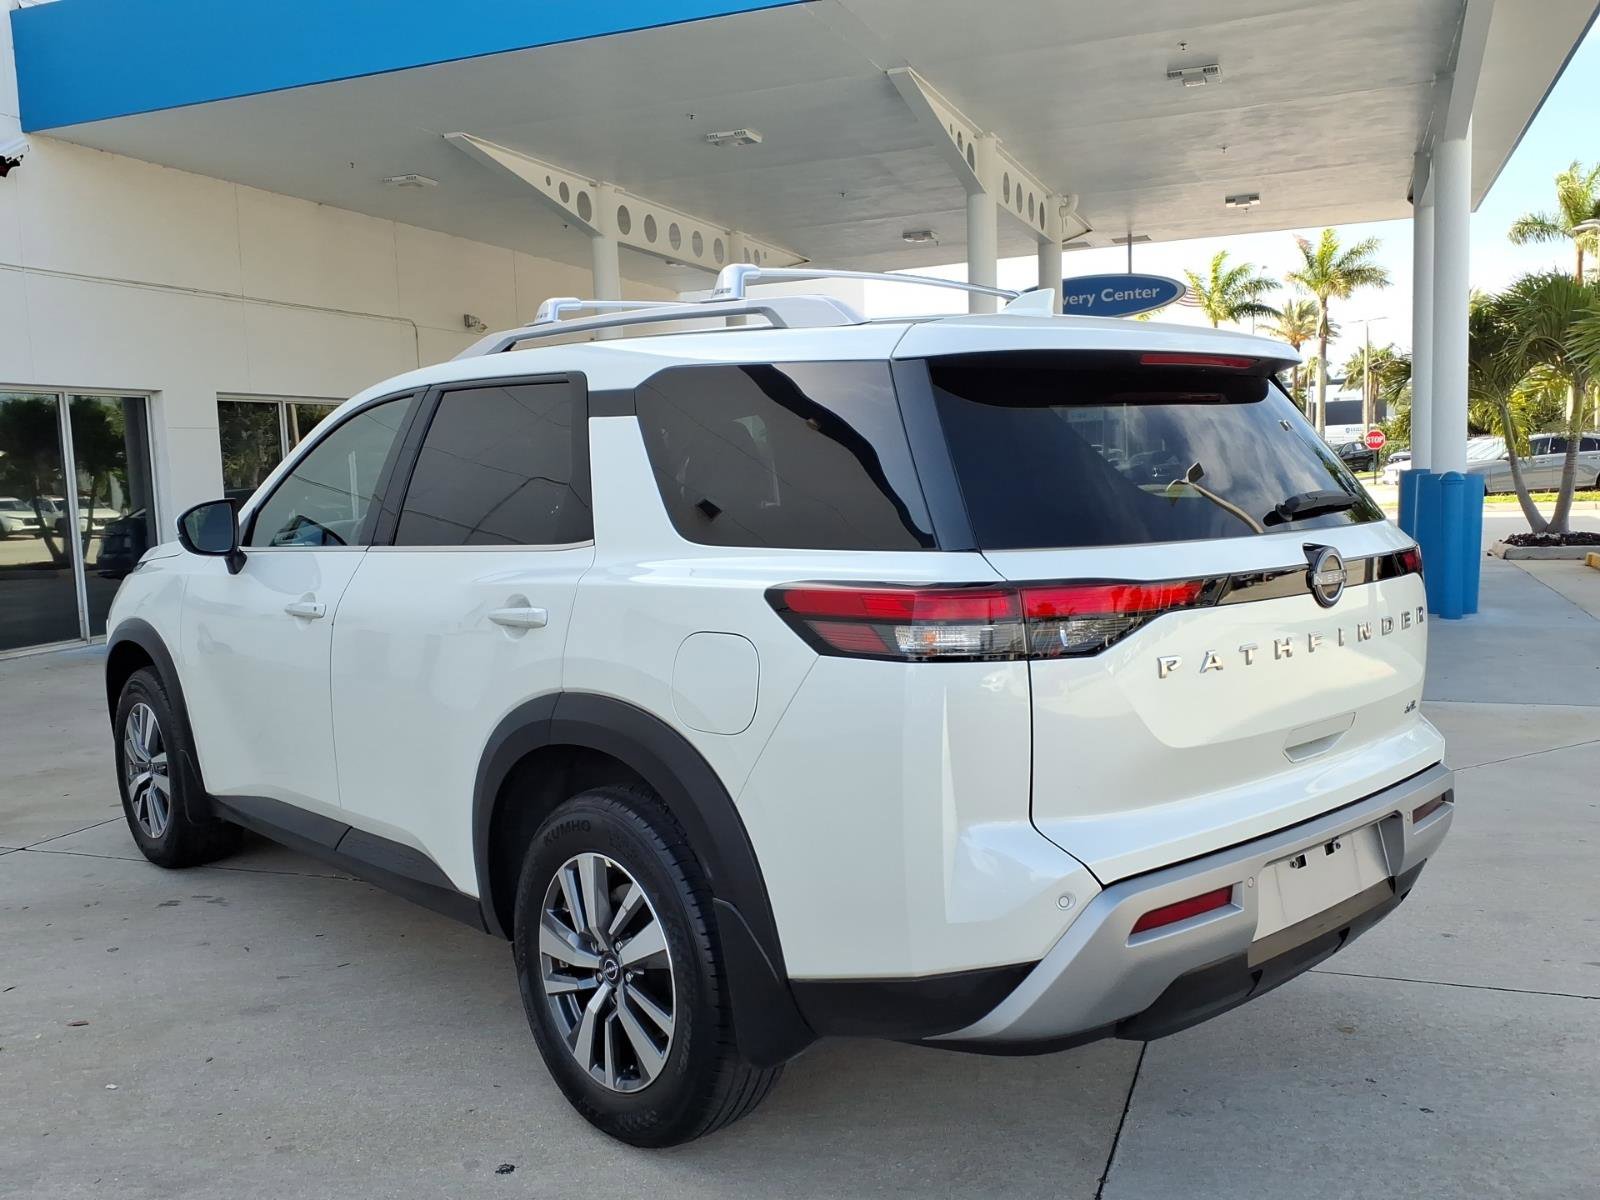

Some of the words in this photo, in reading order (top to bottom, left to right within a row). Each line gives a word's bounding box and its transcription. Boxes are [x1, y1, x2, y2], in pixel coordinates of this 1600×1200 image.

[1101, 286, 1160, 301] Center
[1366, 435, 1384, 444] STOP
[1157, 606, 1425, 679] PATHFINDER
[543, 819, 592, 847] KUMHO
